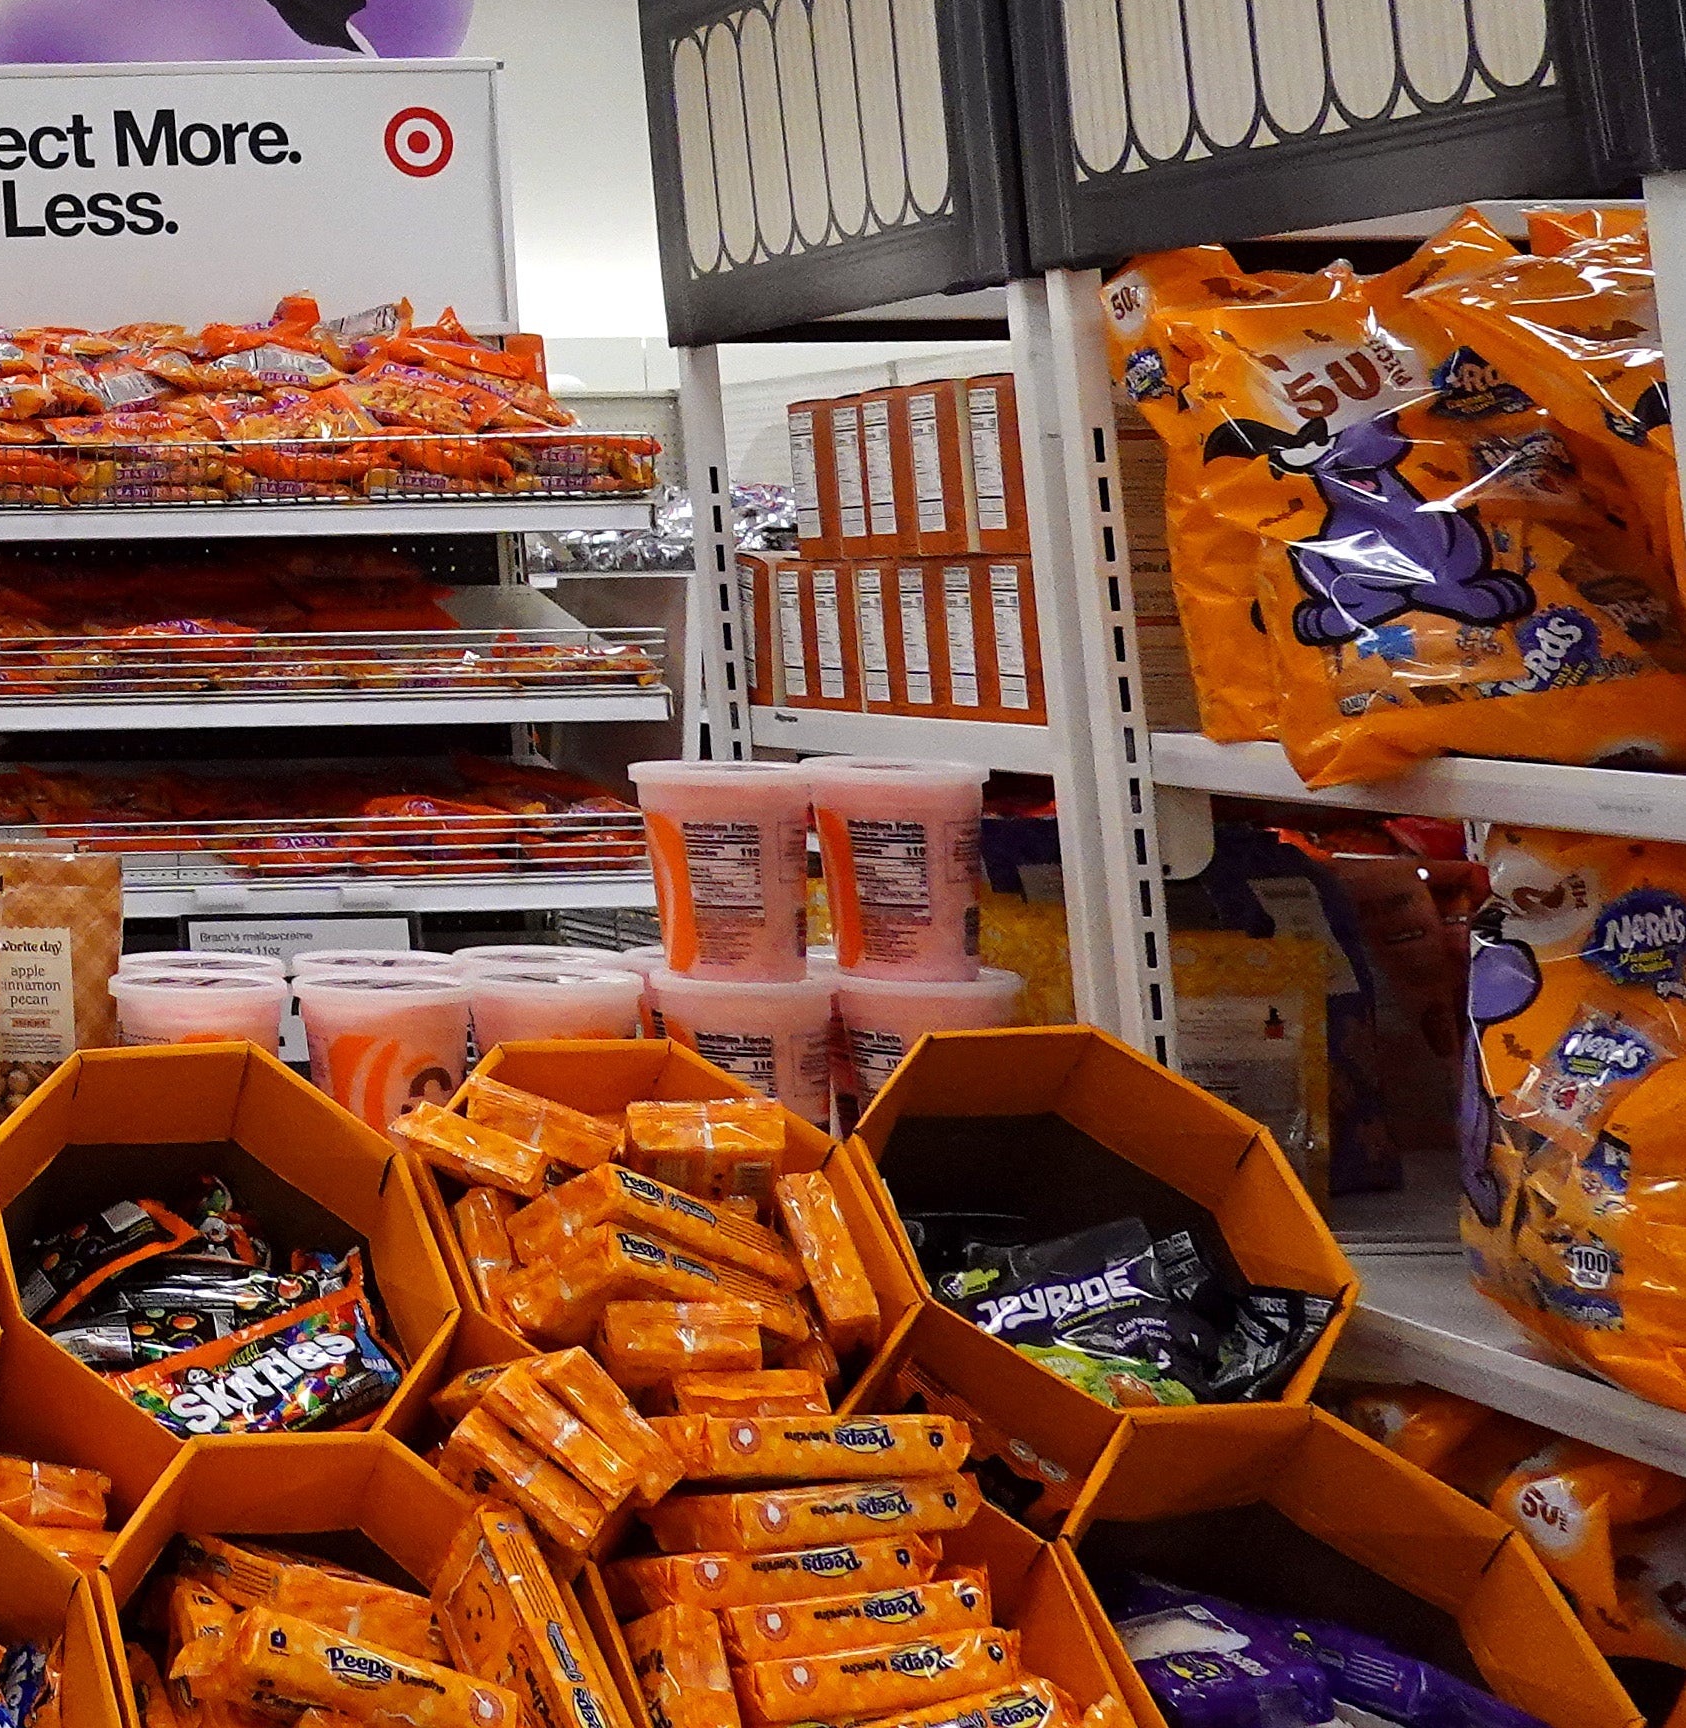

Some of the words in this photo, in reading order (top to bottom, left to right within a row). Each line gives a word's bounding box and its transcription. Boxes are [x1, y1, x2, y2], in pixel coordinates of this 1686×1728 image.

[113, 109, 302, 169] More.
[2, 180, 179, 239] Less.
[1283, 350, 1383, 421] 50
[199, 932, 241, 943] Brach's
[1603, 906, 1686, 953] NERDS
[40, 940, 63, 957] day
[10, 964, 46, 979] apple
[9, 994, 49, 1008] pecan
[1574, 1033, 1646, 1071] NERDS
[613, 1170, 665, 1203] Peeps
[615, 1232, 667, 1261] Peeps
[1575, 1247, 1609, 1275] 100
[976, 1265, 1133, 1336] JOYRIDE
[169, 1333, 356, 1434] SKITTLES
[833, 1424, 896, 1449] Peeps
[856, 1488, 913, 1515] Peeps
[800, 1546, 862, 1573] Peeps
[863, 1590, 926, 1619] Peeps
[325, 1646, 394, 1681] Peeps
